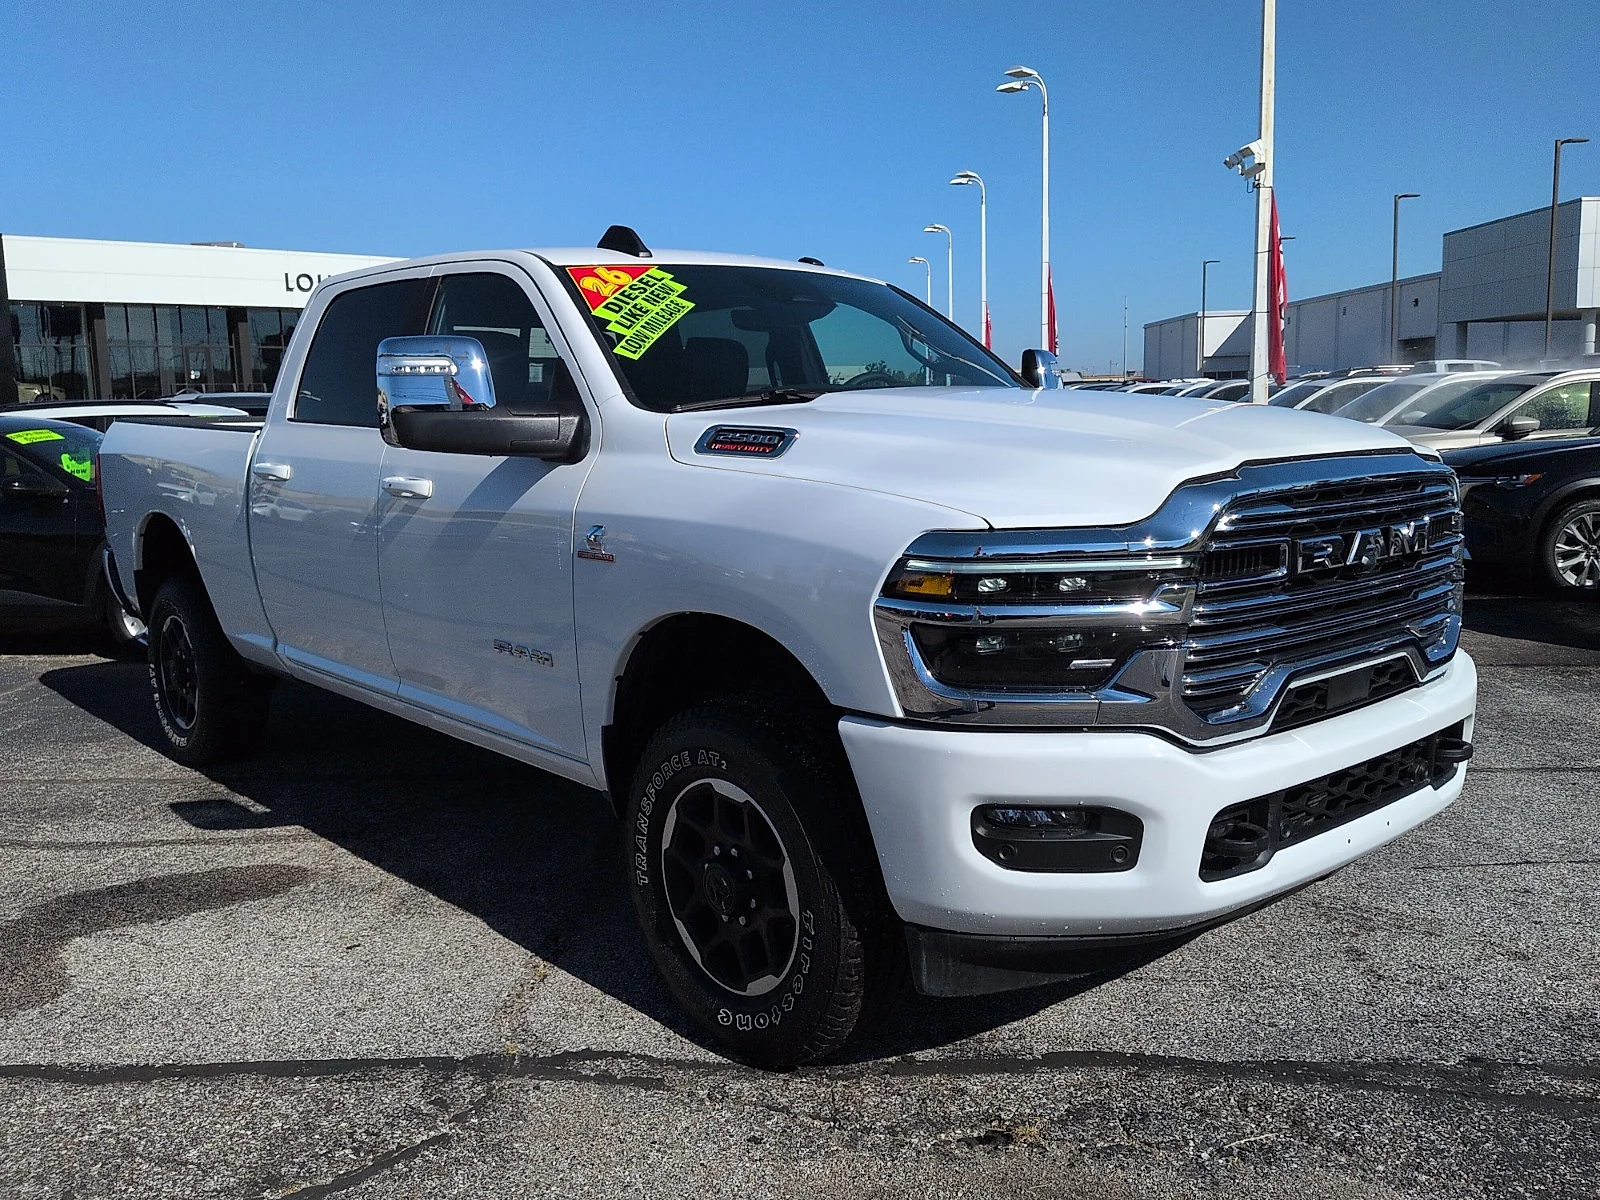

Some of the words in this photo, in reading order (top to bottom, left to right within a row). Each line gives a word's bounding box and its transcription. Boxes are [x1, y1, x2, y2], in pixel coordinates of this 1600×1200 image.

[284, 272, 332, 292] LO
[580, 267, 633, 297] 26
[602, 274, 668, 314] DIESEL
[613, 302, 650, 330] LIKE
[641, 281, 676, 307] NEW
[619, 327, 651, 355] LOW
[643, 299, 687, 335] MILEAGE
[715, 432, 779, 444] 2500
[1296, 518, 1430, 574] RAM
[493, 638, 554, 668] RAM
[635, 750, 691, 886] TRANSFORCE
[717, 909, 815, 1031] Firestone
